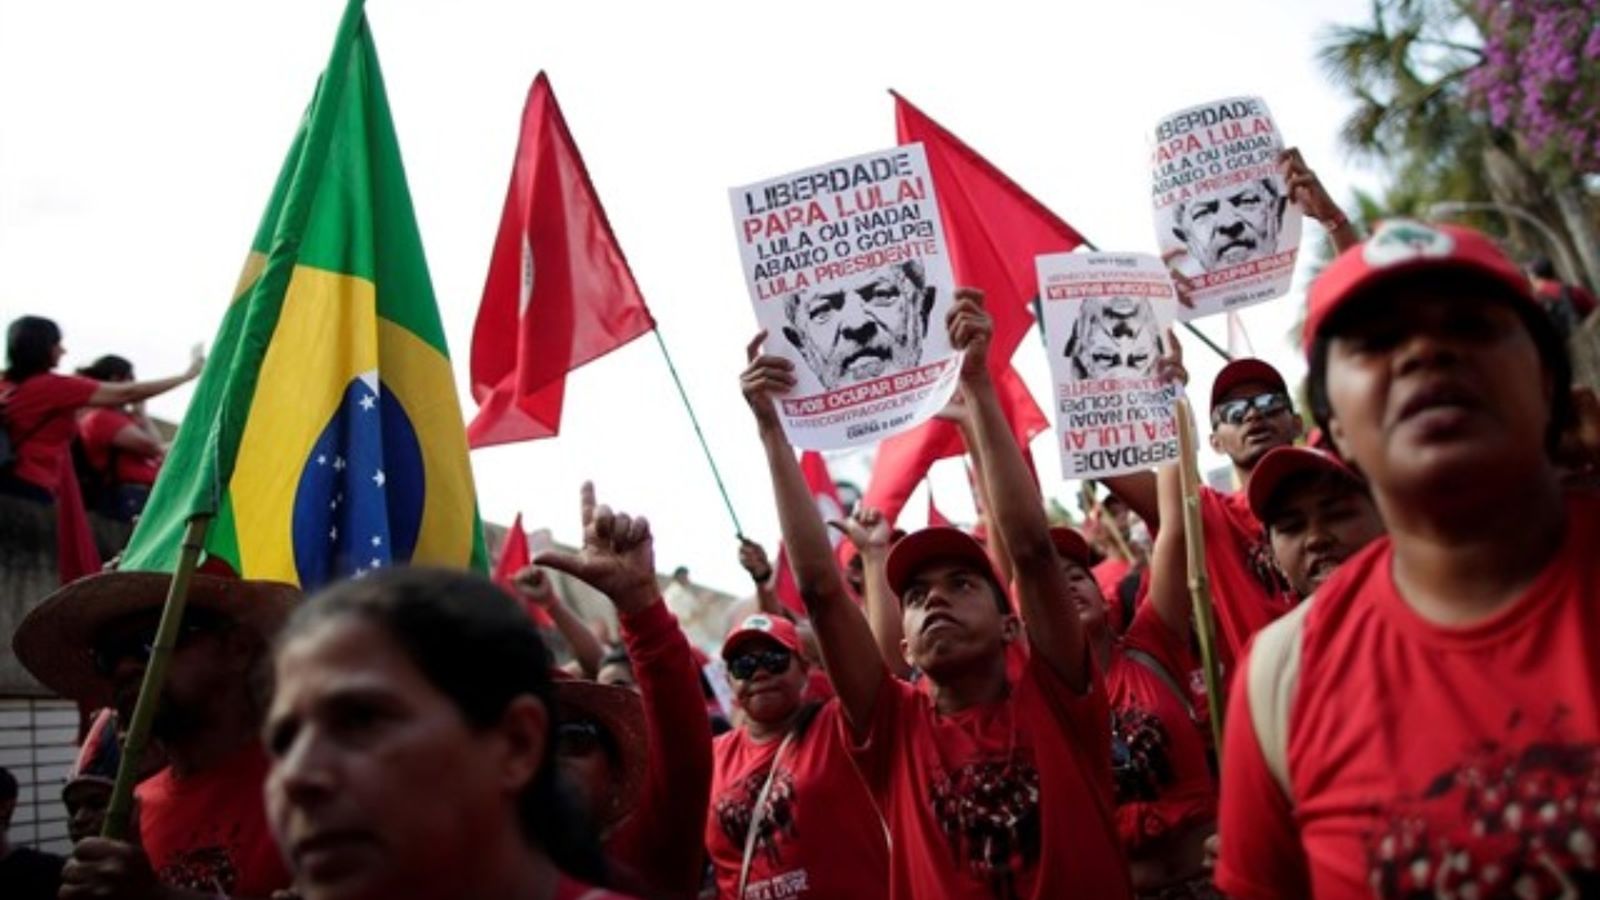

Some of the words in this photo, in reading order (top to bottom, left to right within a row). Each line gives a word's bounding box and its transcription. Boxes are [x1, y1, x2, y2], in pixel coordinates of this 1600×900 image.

[1154, 133, 1202, 163] ARA
[1207, 117, 1272, 145] LULA!
[1155, 100, 1262, 142] IBERDADE
[1196, 148, 1220, 165] OU
[1209, 162, 1222, 175] O
[745, 153, 913, 215] LIBERDADE
[743, 200, 828, 243] PARA
[835, 177, 927, 217] LULA!
[757, 231, 813, 260] LULA
[819, 222, 849, 242] OU
[855, 204, 921, 233] NADA!
[754, 247, 828, 281] ABAIXO
[835, 241, 850, 257] O
[857, 221, 934, 250] GOLPE!
[755, 272, 810, 300] LULA
[815, 240, 938, 283] PRESIDENTE
[829, 382, 891, 406] OCUPAR
[1064, 424, 1136, 450] LULA!
[1073, 441, 1178, 473] BERDADE
